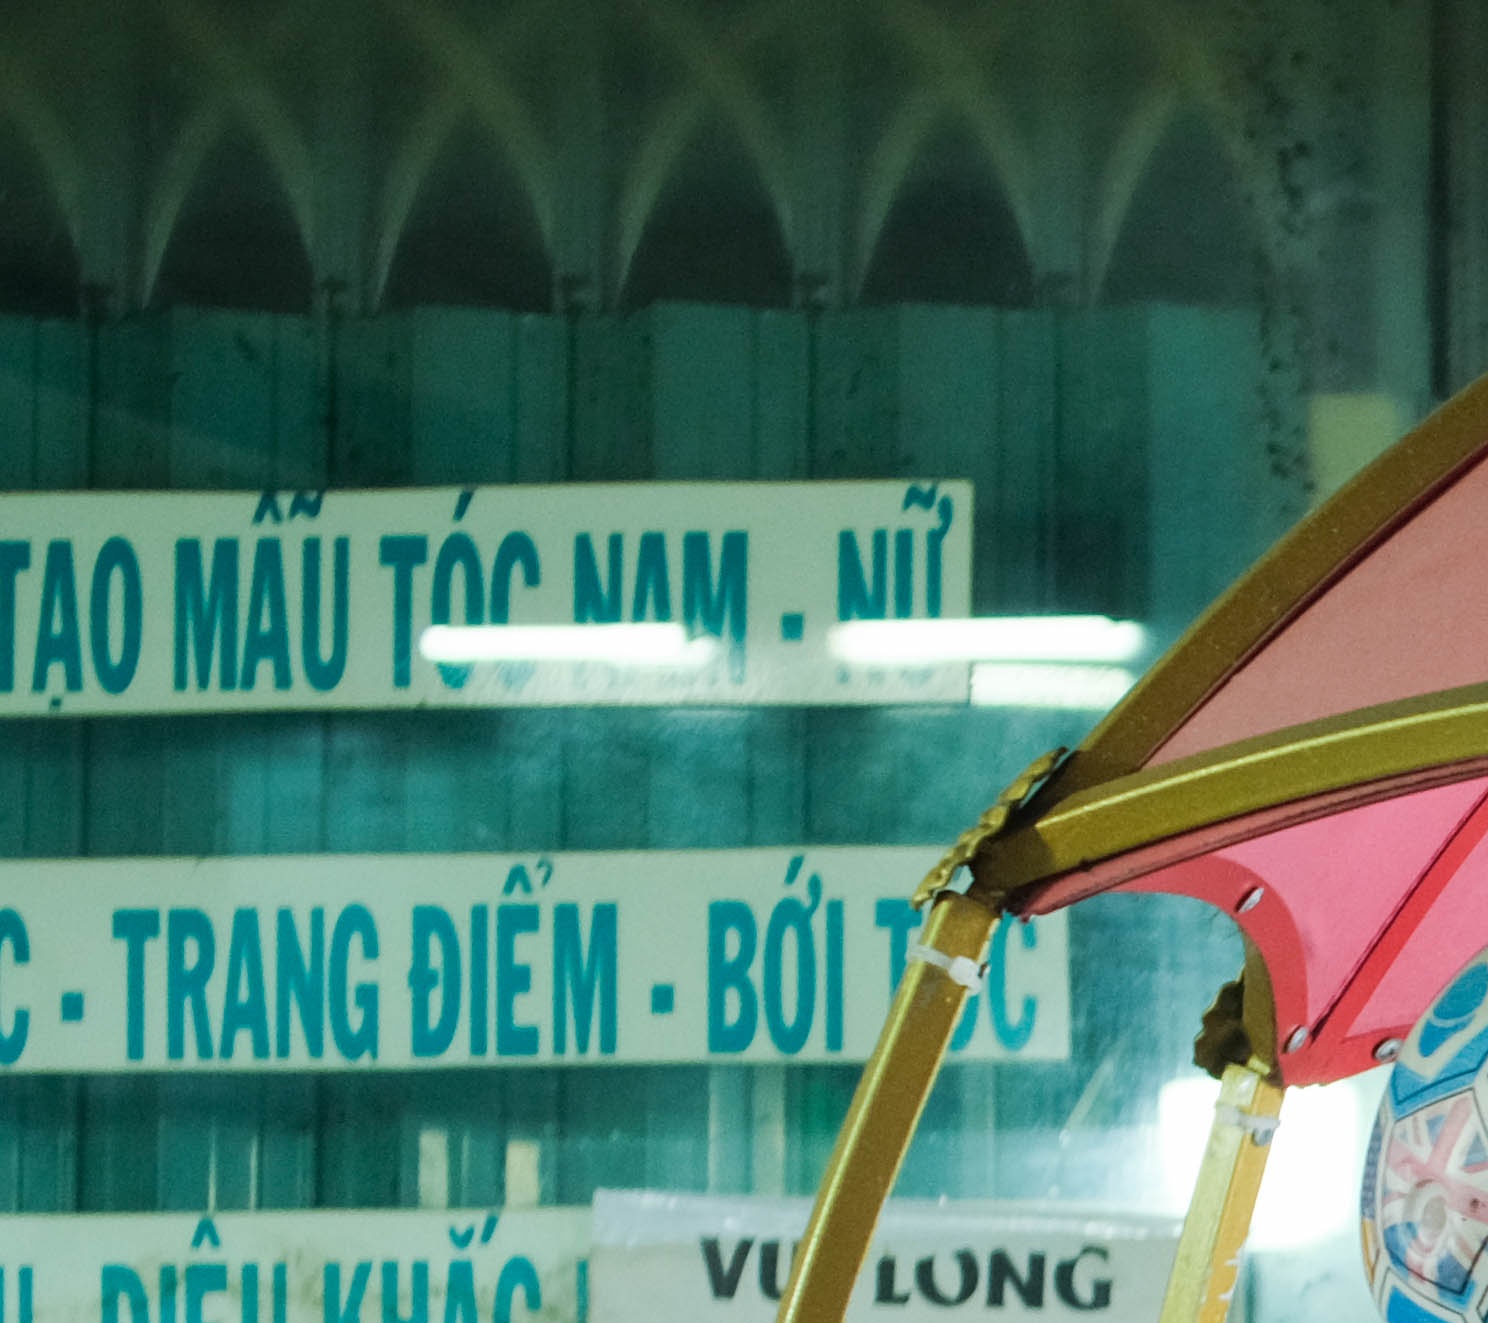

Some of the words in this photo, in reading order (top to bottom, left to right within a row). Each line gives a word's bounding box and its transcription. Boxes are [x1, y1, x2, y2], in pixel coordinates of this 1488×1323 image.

[0, 533, 143, 711] TẠO
[173, 488, 350, 692] MẪU
[378, 489, 541, 690] TÓC
[574, 530, 748, 685] NAM
[837, 483, 953, 685] NỮ
[112, 904, 379, 1061] TRANG
[408, 857, 618, 1057] ĐIỂM
[707, 855, 844, 1054] BỚI
[875, 897, 1038, 1052] TC
